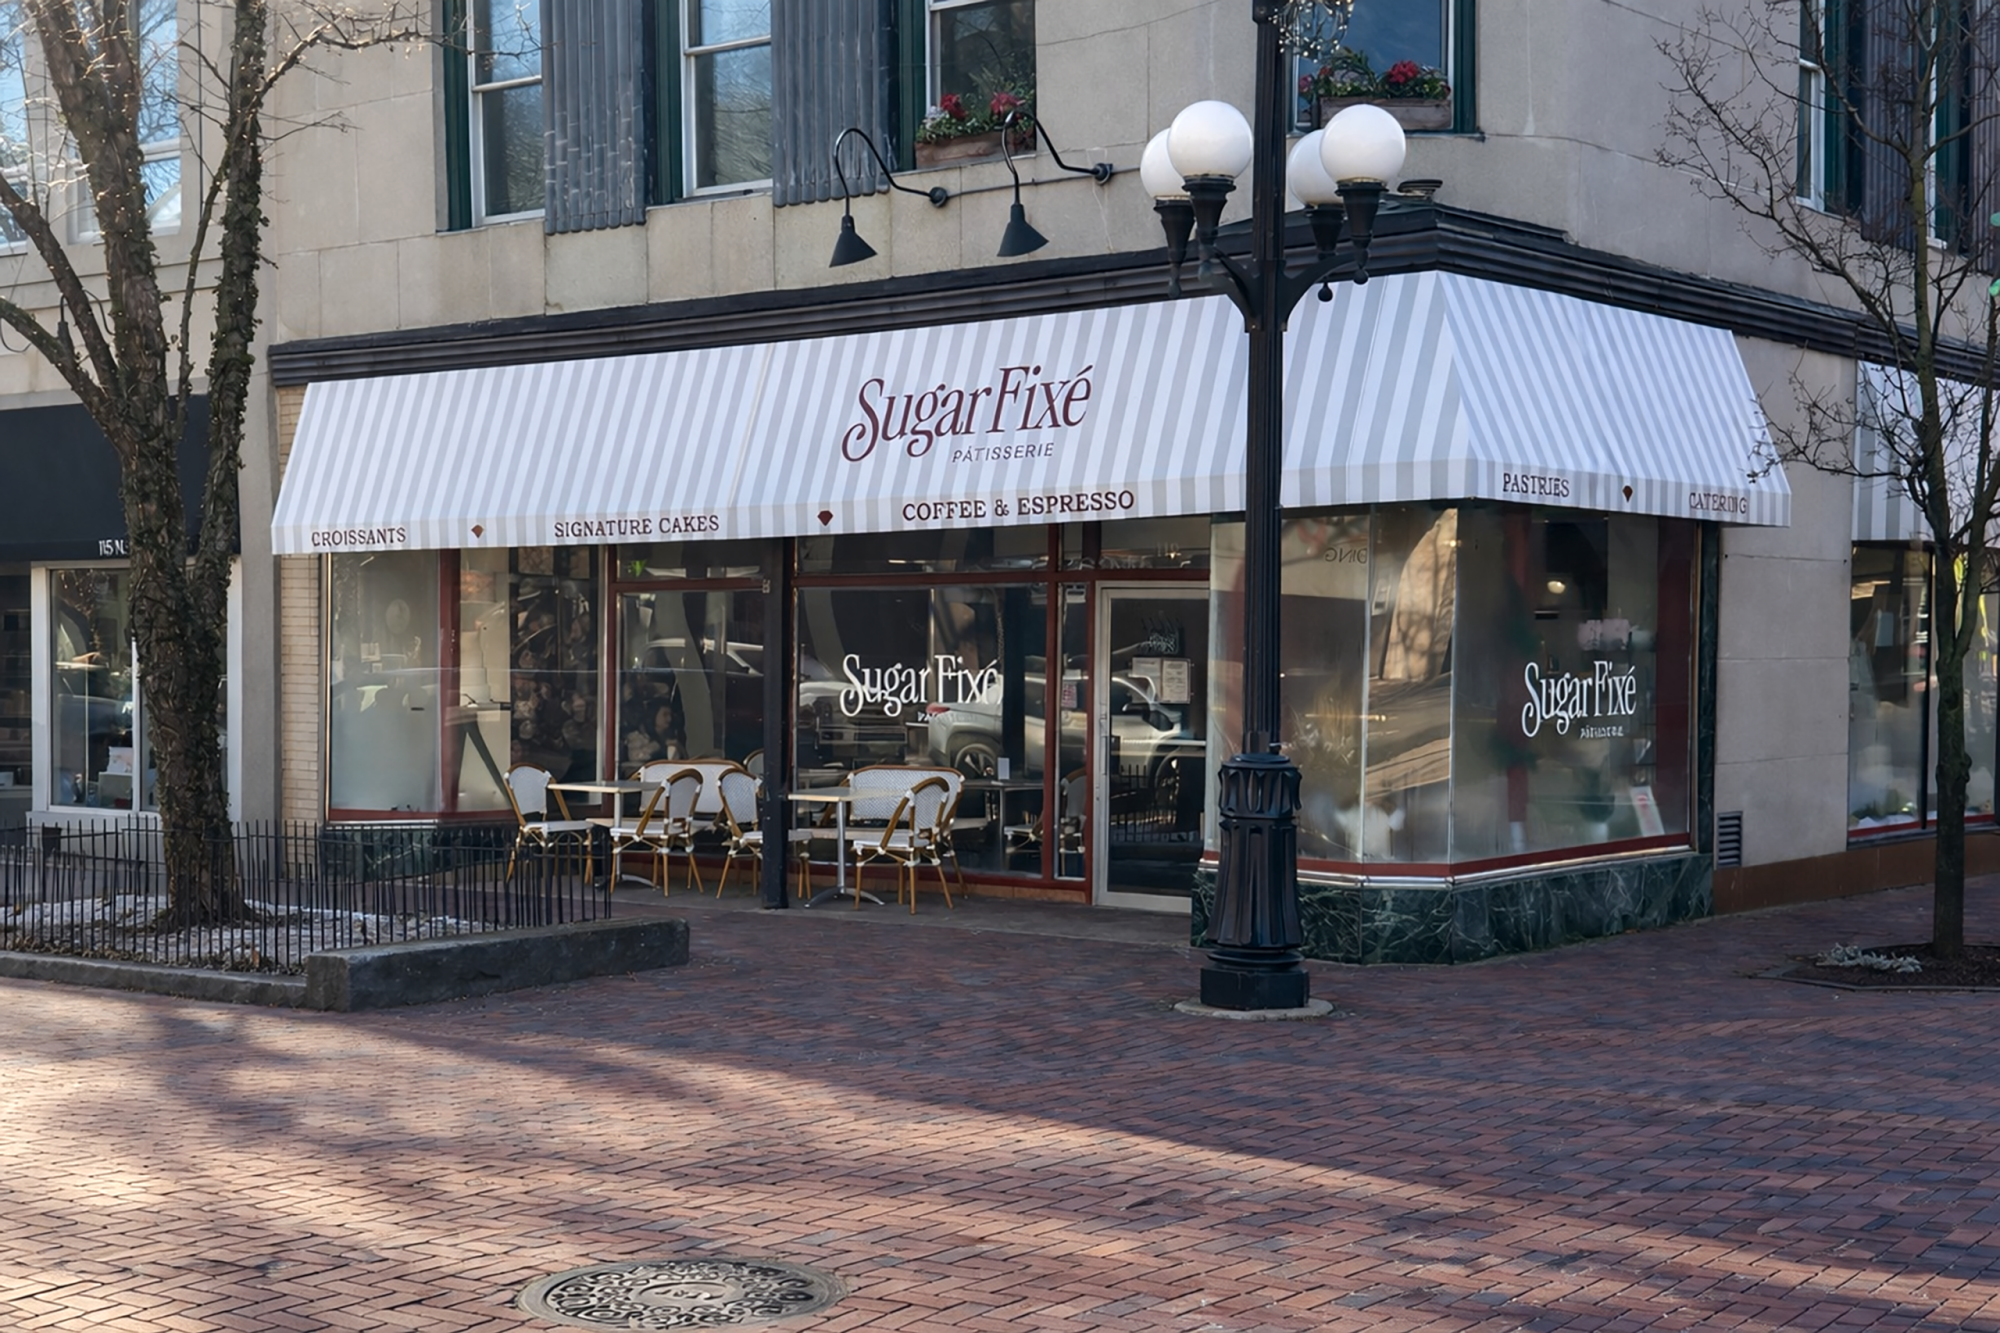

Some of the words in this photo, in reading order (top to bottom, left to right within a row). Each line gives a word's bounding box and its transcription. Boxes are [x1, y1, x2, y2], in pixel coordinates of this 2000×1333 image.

[842, 378, 992, 462] Sugar
[985, 365, 1094, 435] Fixé
[1502, 472, 1570, 497] PASTRIES
[902, 500, 986, 521] COFFEE
[994, 498, 1010, 517] &
[1017, 490, 1135, 516] ESPRESSO
[311, 527, 406, 547] CROISSANTS
[554, 518, 652, 538] SIGNATURE
[658, 515, 720, 534] CAKES
[839, 654, 931, 717] Sugar
[1521, 662, 1593, 737] Sugar
[1593, 660, 1637, 716] Fixé
